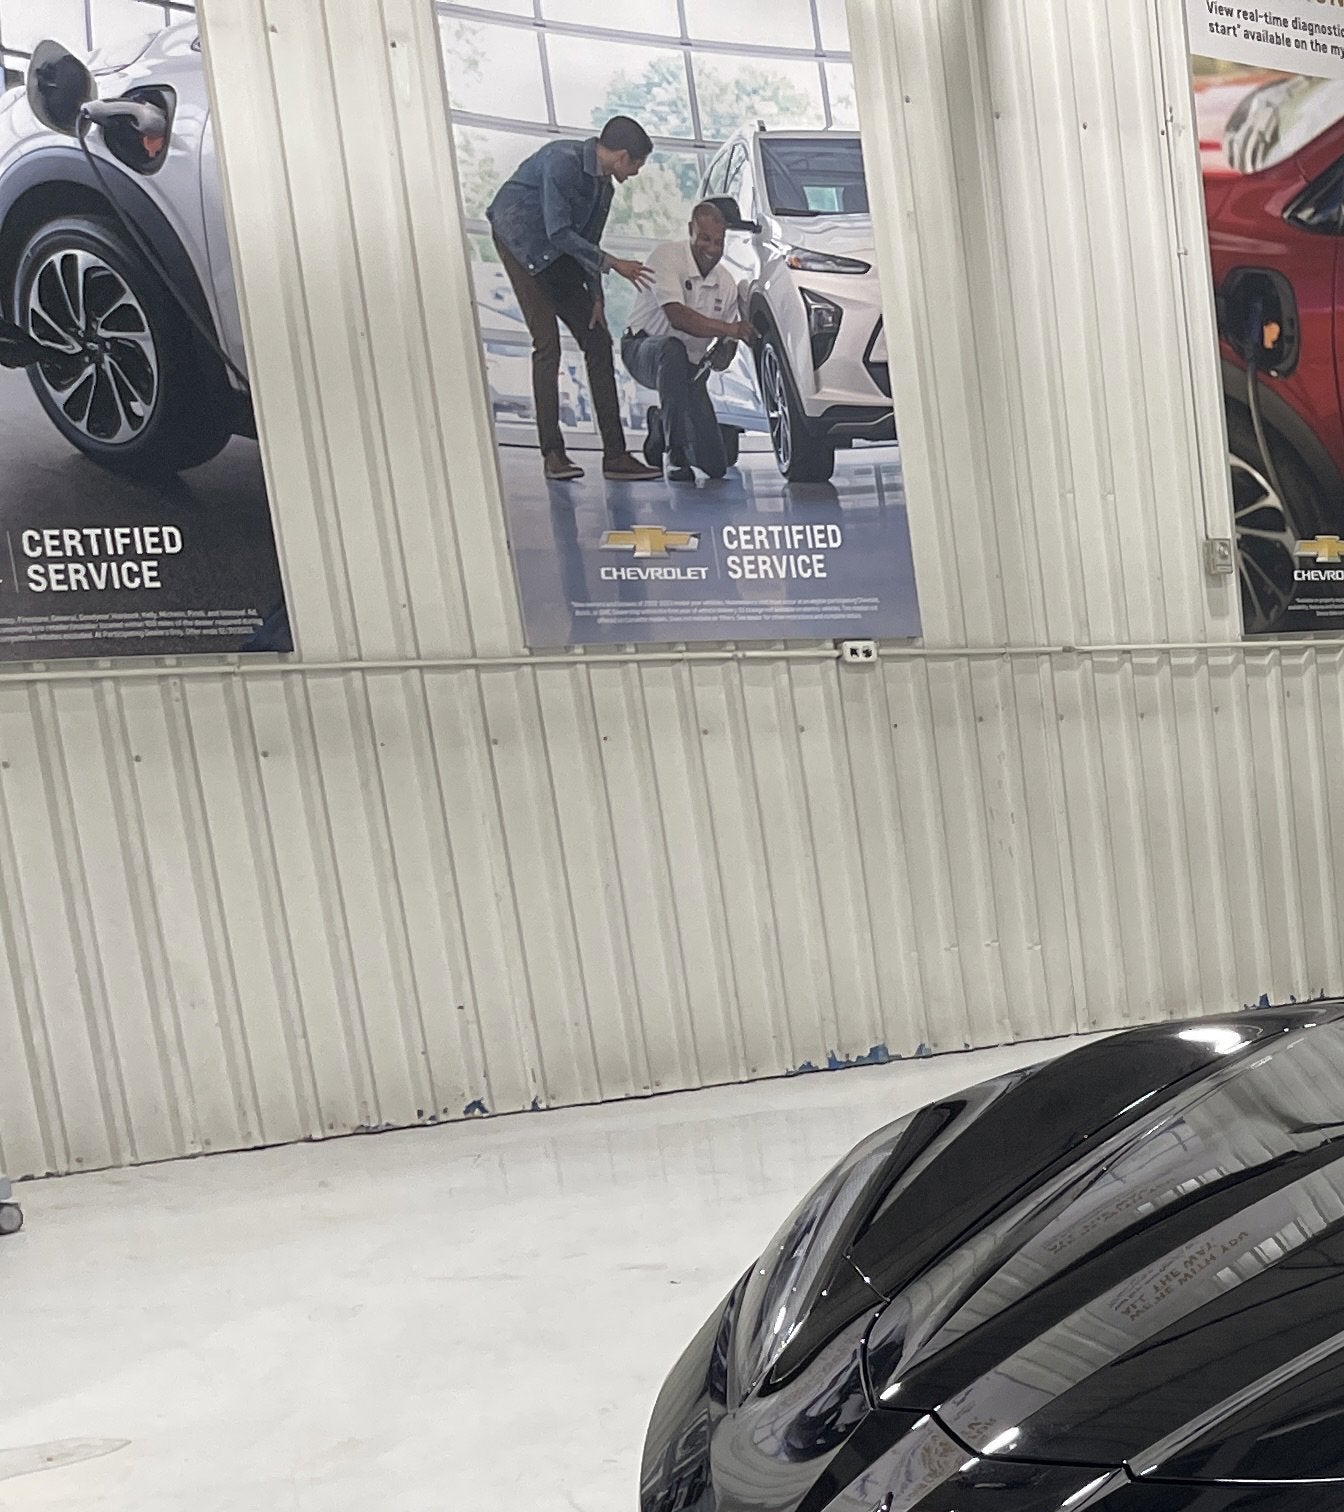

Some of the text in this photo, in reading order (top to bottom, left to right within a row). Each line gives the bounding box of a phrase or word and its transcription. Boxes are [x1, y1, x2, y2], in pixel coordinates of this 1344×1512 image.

[1206, 1, 1234, 18] View
[1237, 9, 1289, 28] real-time
[1243, 29, 1292, 48] available
[1294, 39, 1308, 51] on
[1310, 39, 1328, 53] the
[22, 525, 183, 558] CERTIFIED
[722, 524, 842, 550] CERTIFIED
[27, 560, 162, 592] SERVICE
[601, 566, 709, 581] CHEVROLET
[727, 554, 827, 579] SERVICE
